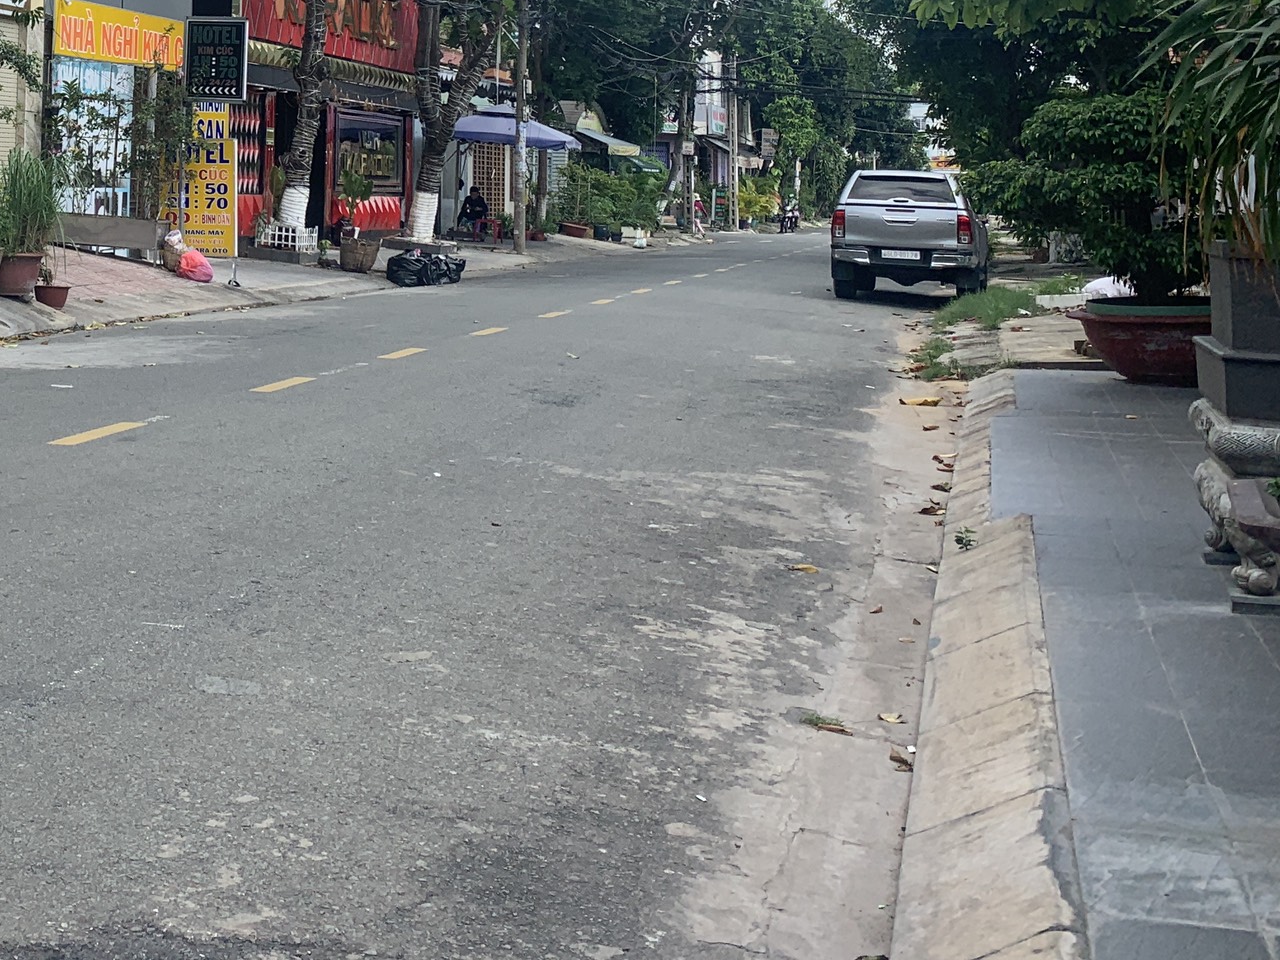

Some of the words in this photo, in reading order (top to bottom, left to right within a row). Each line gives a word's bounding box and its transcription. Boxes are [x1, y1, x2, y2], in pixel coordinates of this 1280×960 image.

[60, 8, 96, 55] NHÀ
[101, 14, 139, 61] NGHỈ
[142, 28, 170, 65] KIM
[192, 25, 240, 44] HOTEL
[197, 46, 214, 55] KIM
[215, 44, 234, 56] CÚC
[219, 56, 239, 67] 50
[218, 68, 238, 79] 70
[204, 183, 229, 195] 50
[204, 197, 229, 210] 70
